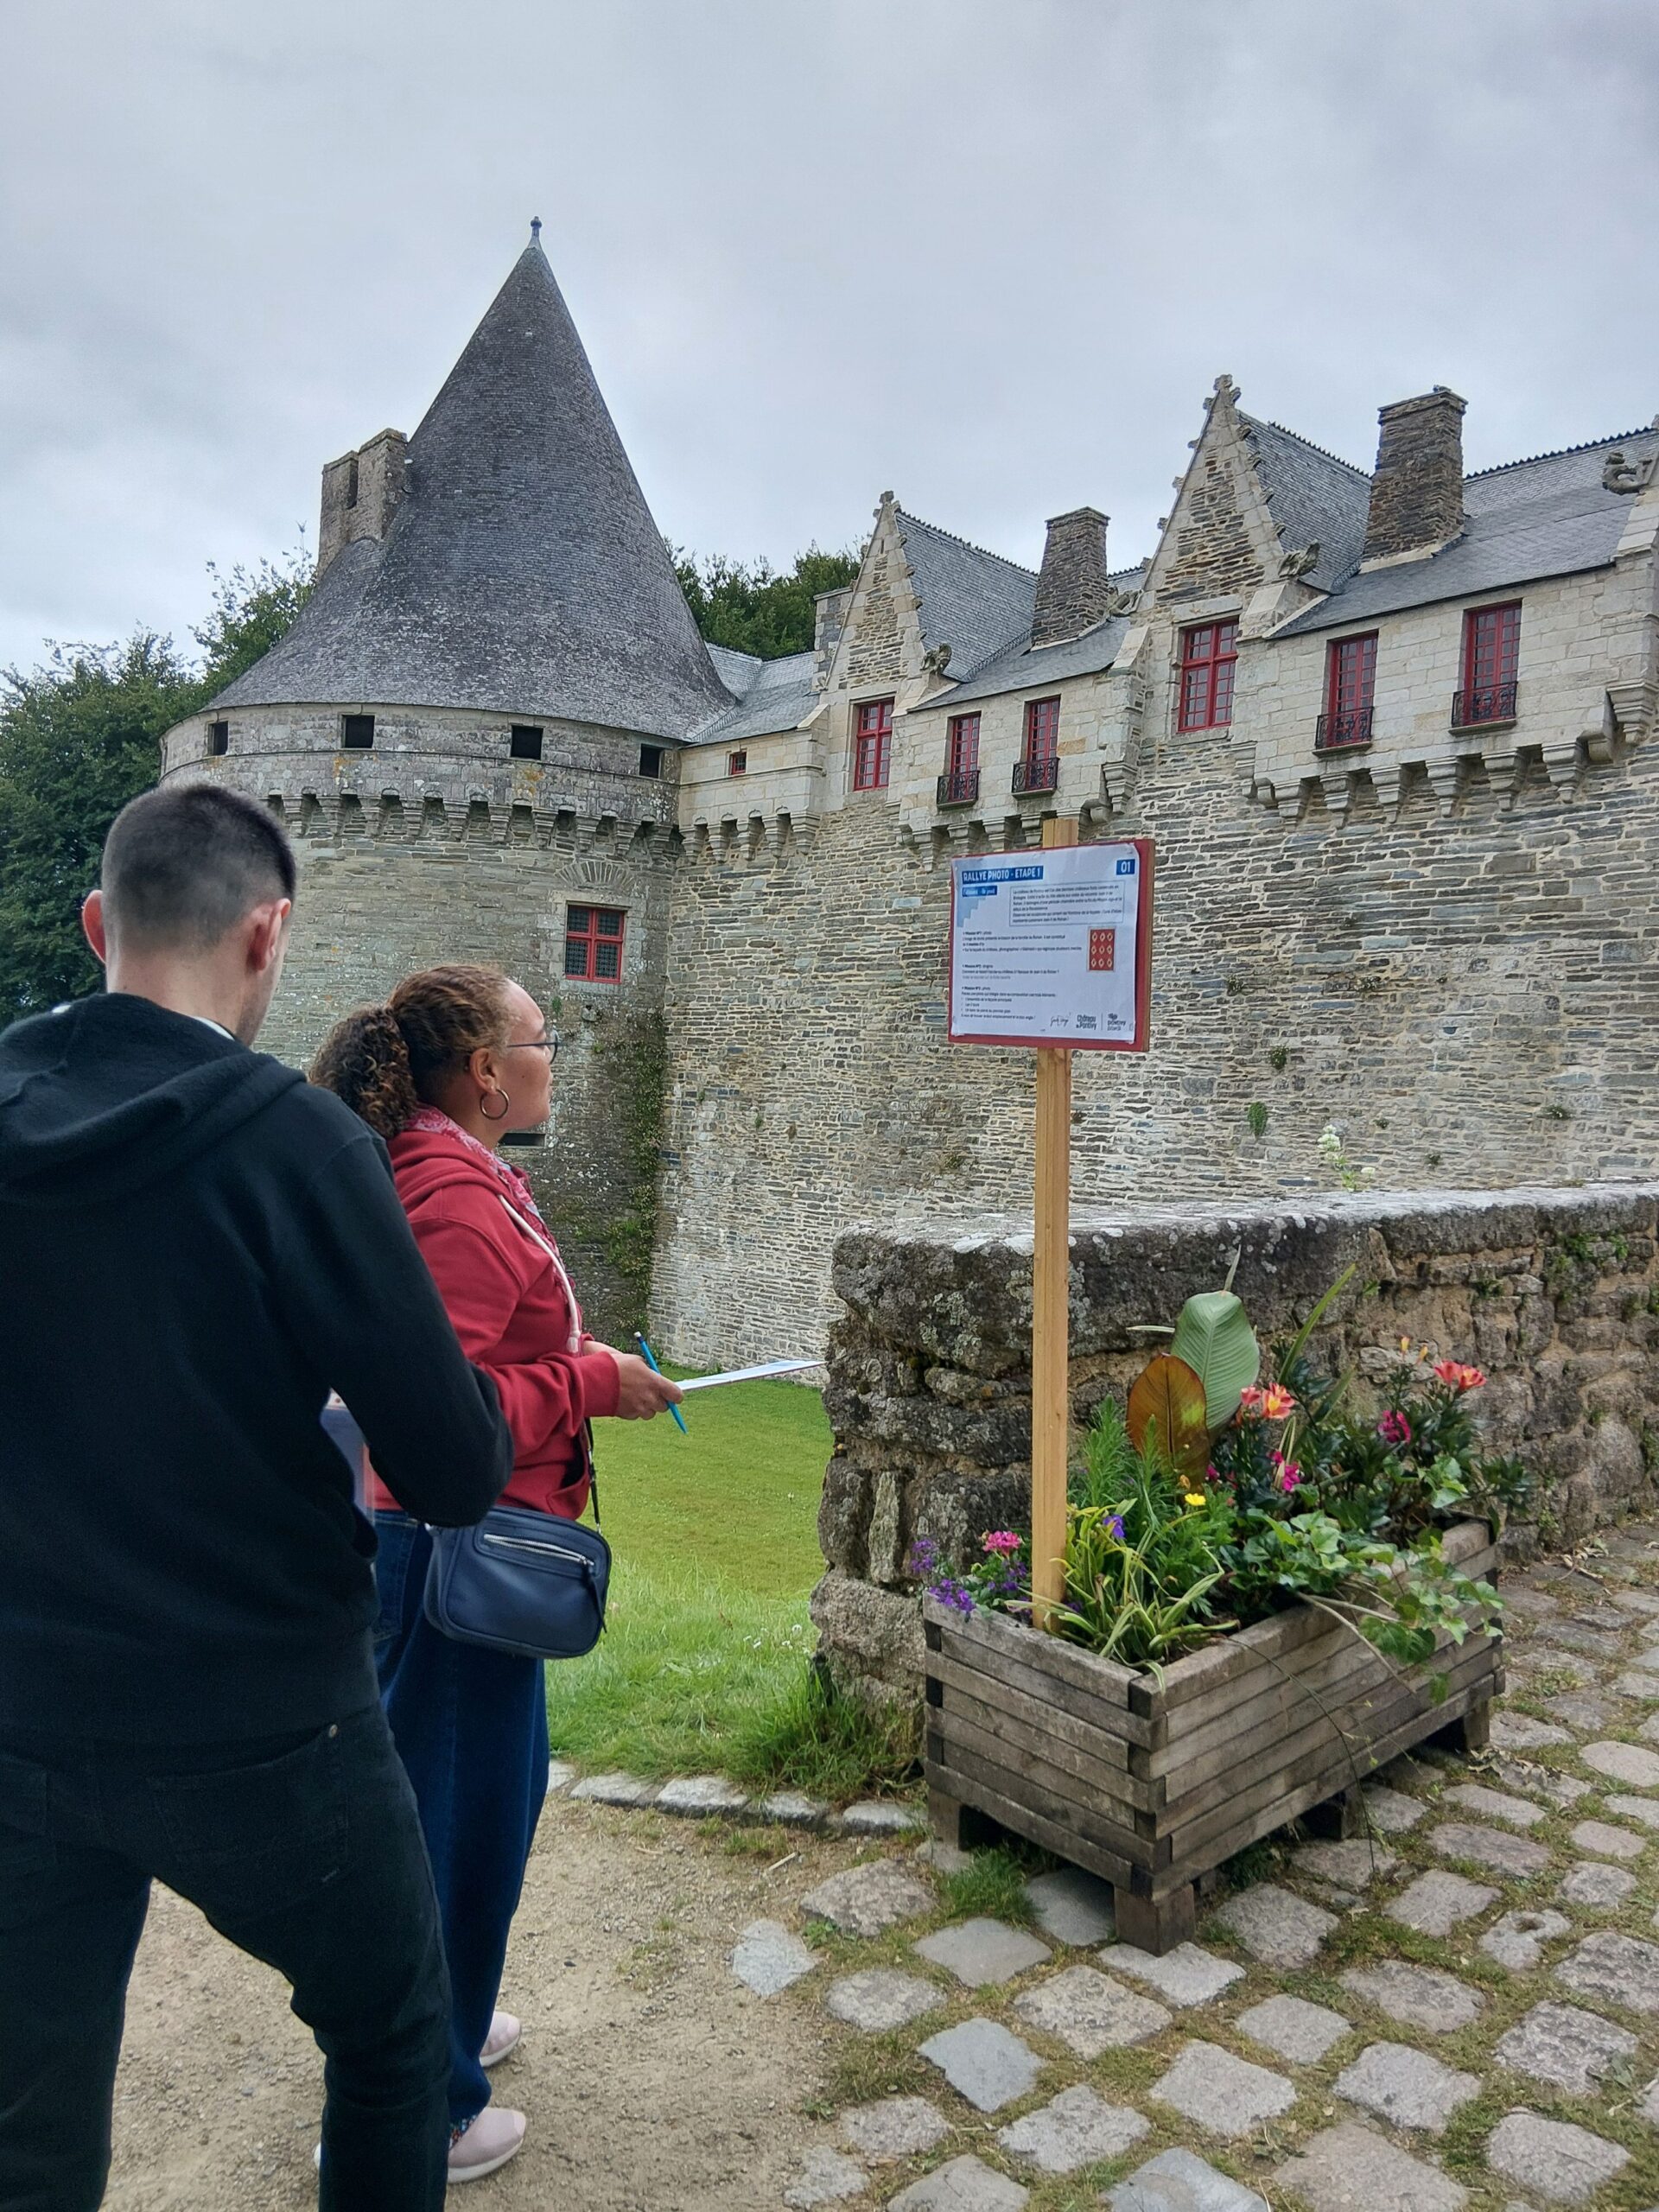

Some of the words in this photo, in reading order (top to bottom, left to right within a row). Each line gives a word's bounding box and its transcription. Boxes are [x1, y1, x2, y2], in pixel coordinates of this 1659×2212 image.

[1121, 861, 1131, 873] 01
[963, 870, 987, 881] RALLYE
[988, 868, 1009, 880] PHOTO
[1014, 867, 1036, 879] ETAPE
[1037, 867, 1040, 877] 1
